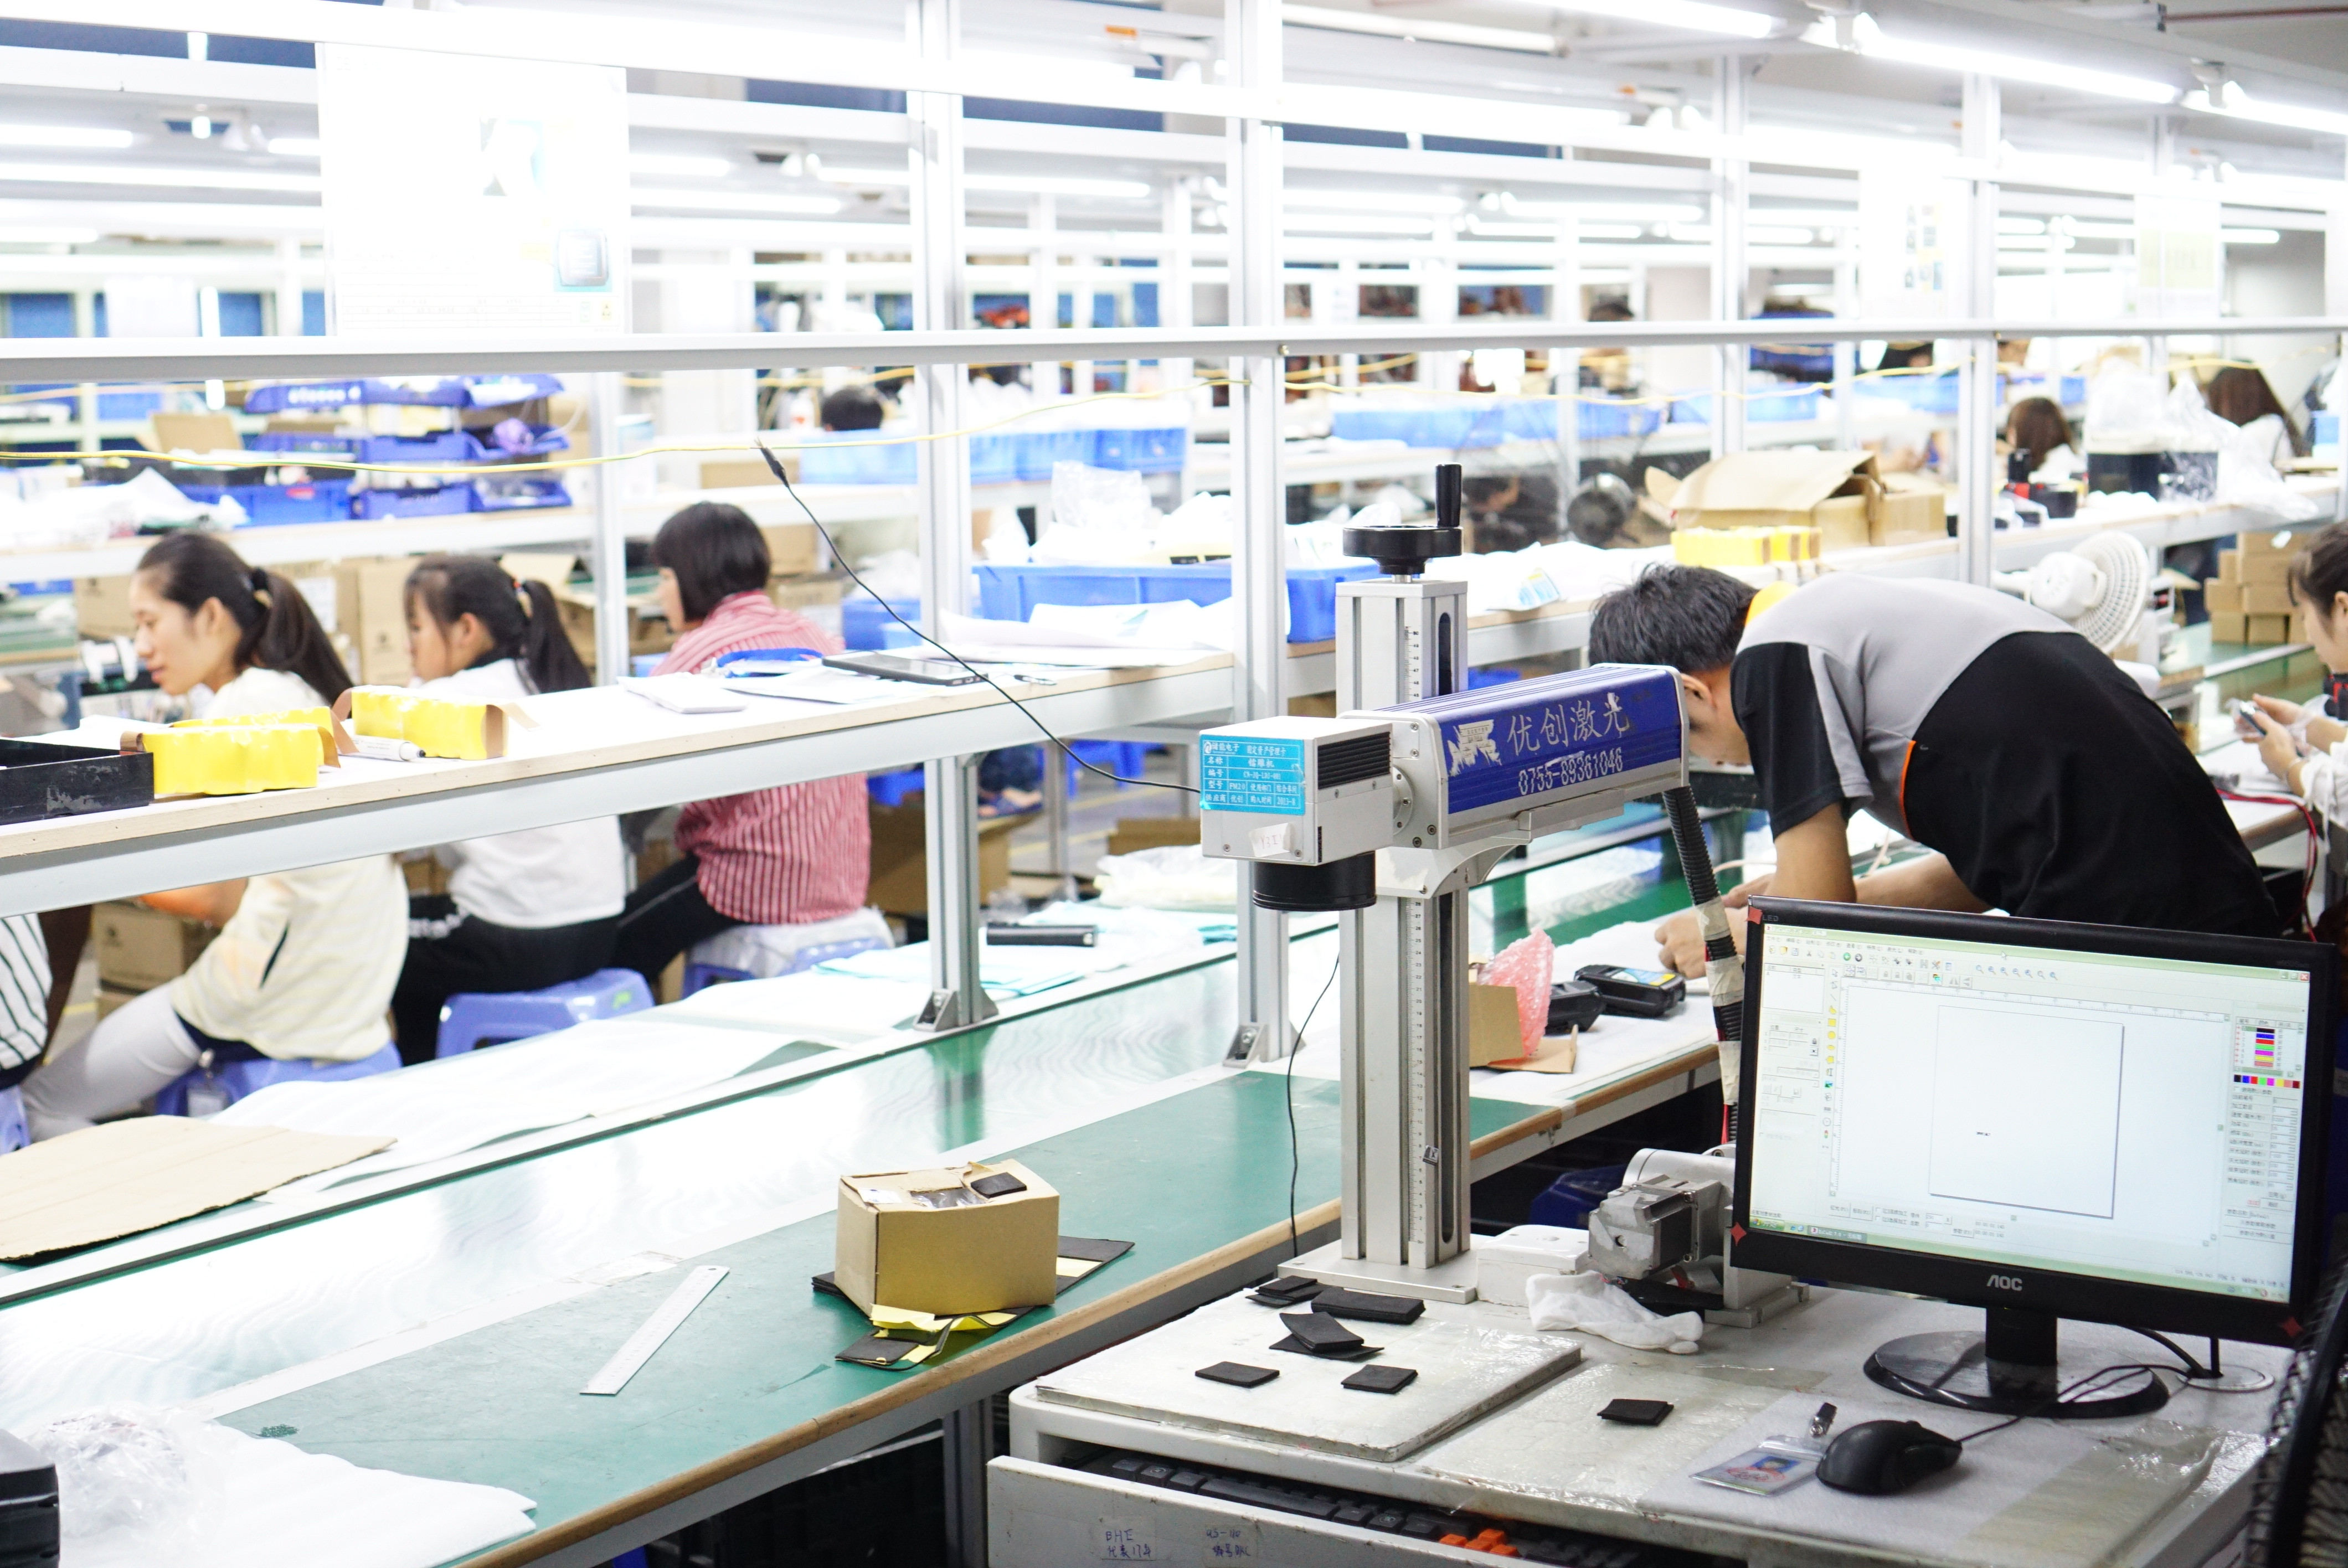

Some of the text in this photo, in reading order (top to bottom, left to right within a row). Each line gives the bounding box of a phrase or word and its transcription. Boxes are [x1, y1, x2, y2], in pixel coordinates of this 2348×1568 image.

[1507, 694, 1630, 756] 优创激光
[1207, 756, 1223, 765] 名称
[1208, 769, 1223, 777] 编号
[1518, 747, 1623, 796] 0755-89361046
[1208, 780, 1223, 789] 型号
[1986, 1275, 2023, 1292] AOC
